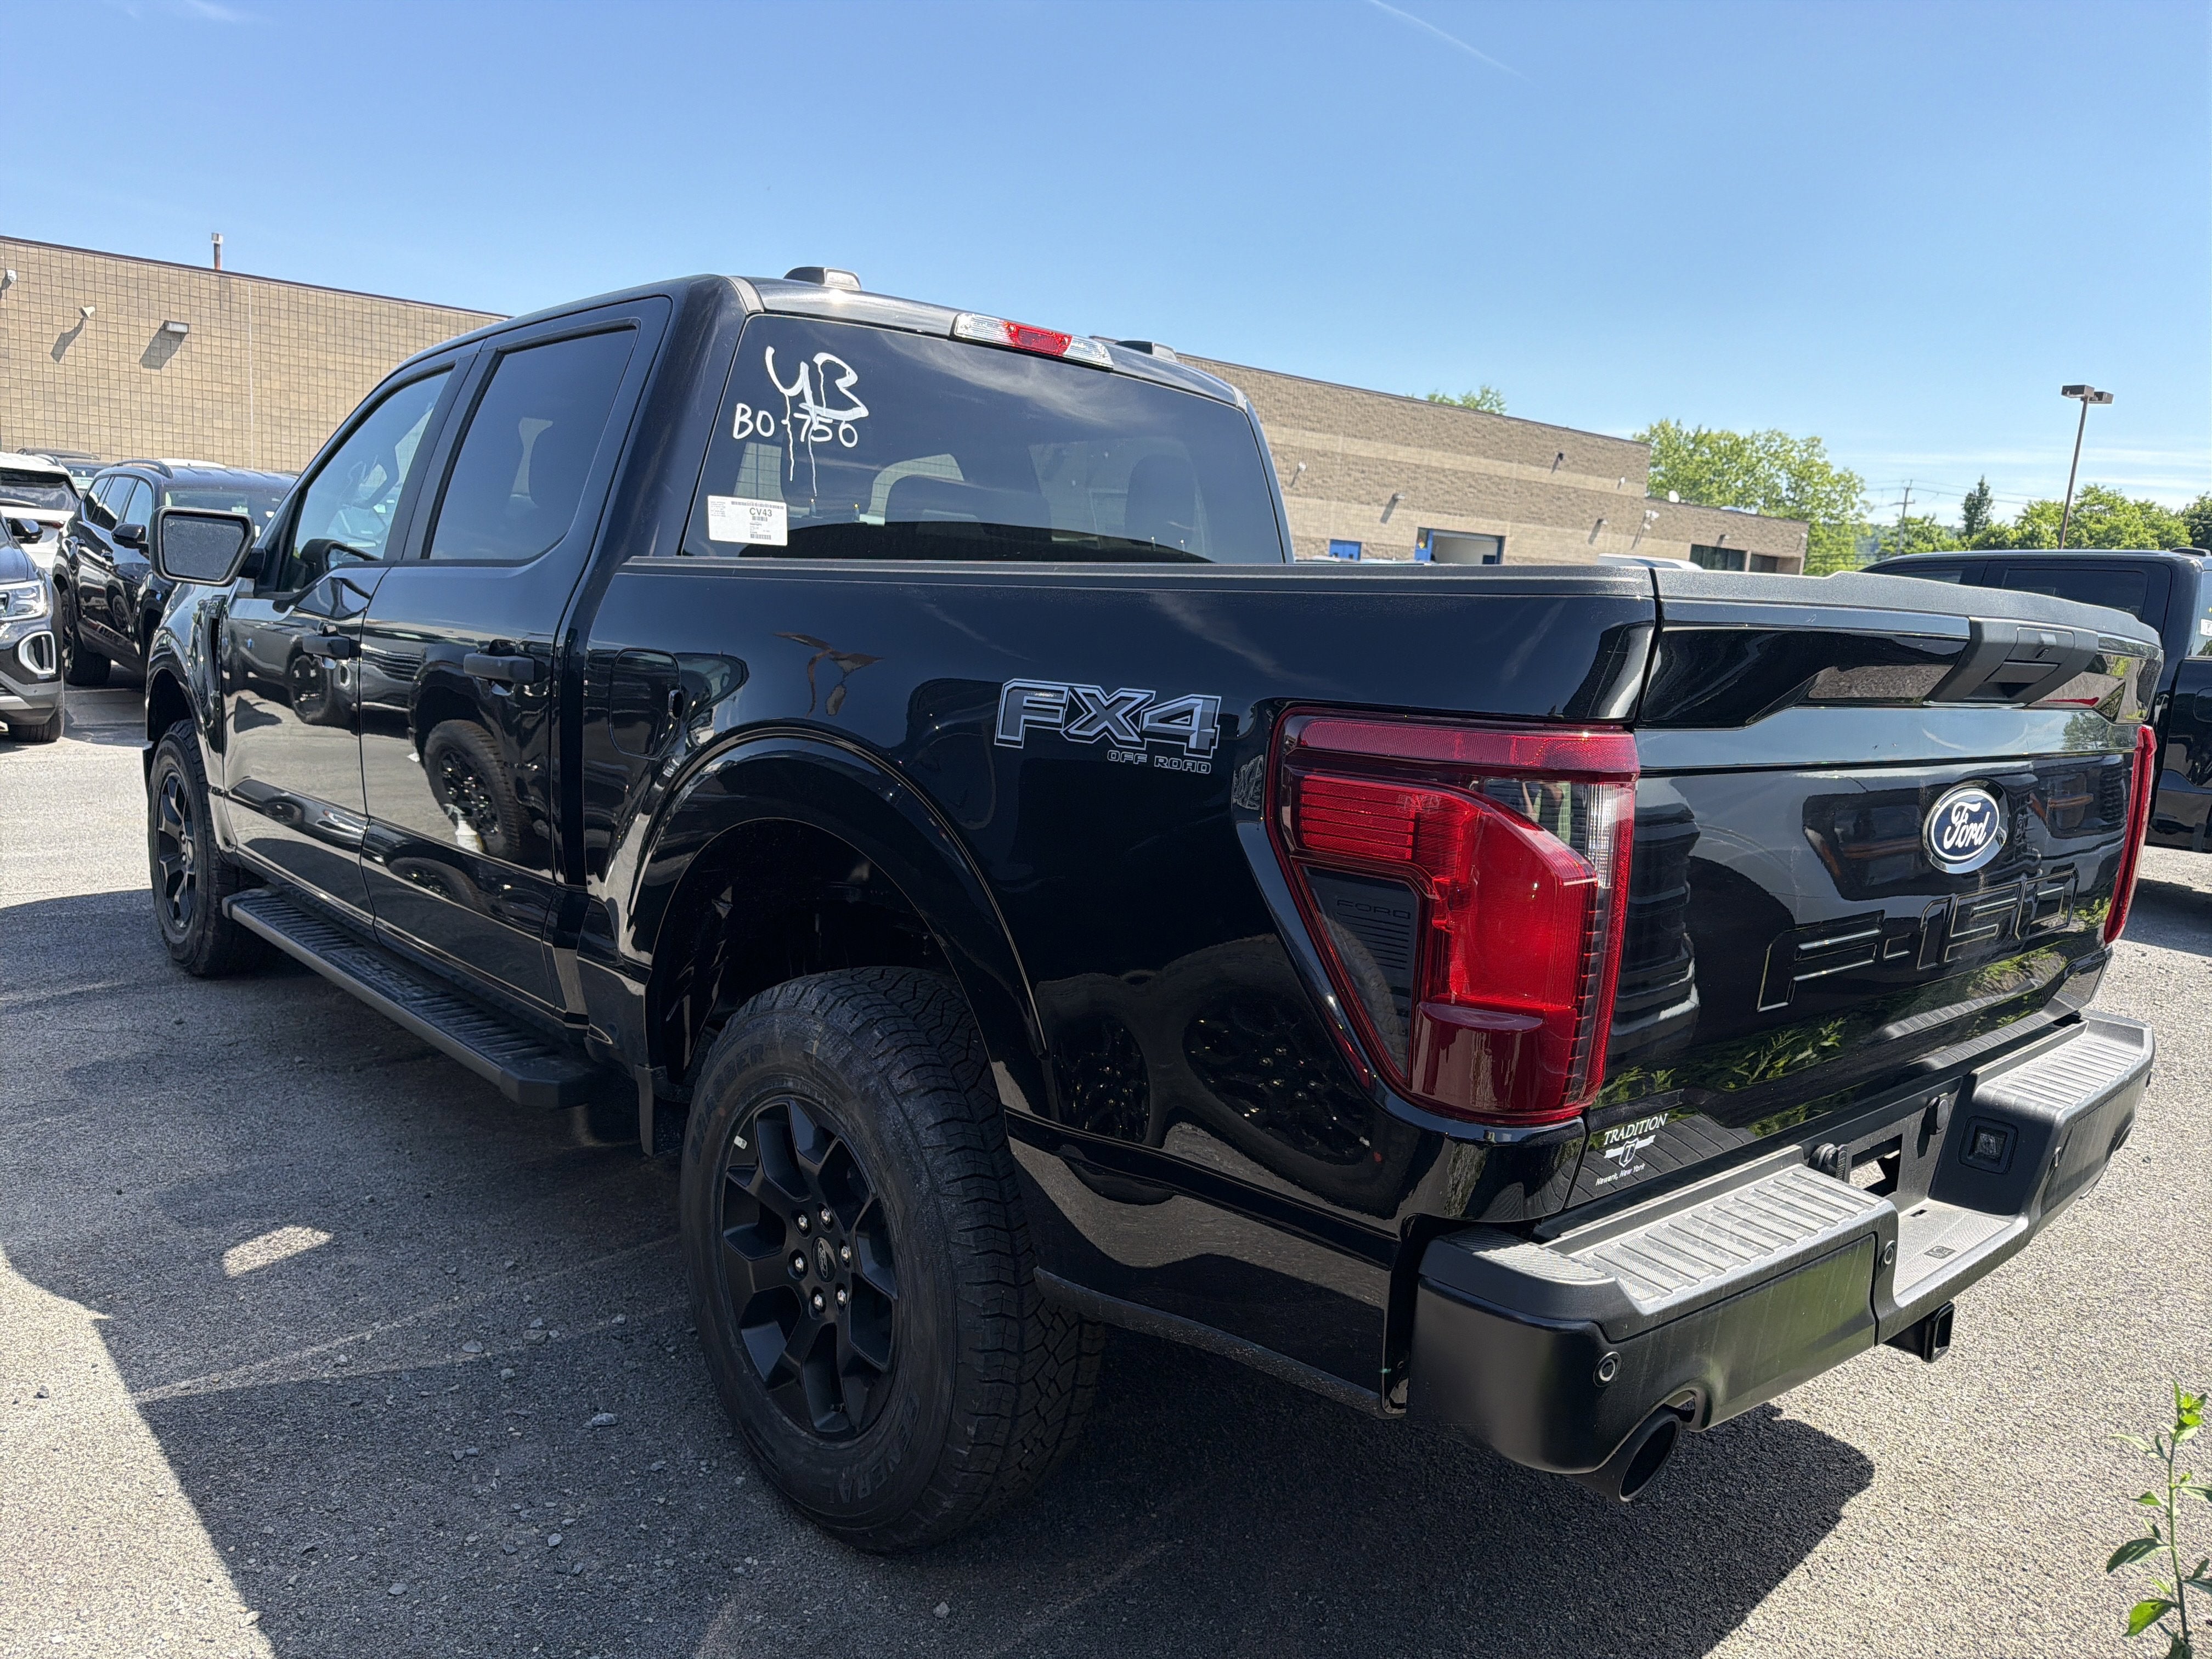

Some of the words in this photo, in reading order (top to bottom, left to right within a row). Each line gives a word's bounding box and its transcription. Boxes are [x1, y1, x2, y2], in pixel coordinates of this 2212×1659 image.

[749, 507, 772, 517] CV43
[994, 678, 1222, 759] FX4
[1107, 749, 1148, 765] OFF
[1154, 755, 1211, 775] ROAD
[1942, 800, 1991, 850] Ford
[1336, 899, 1411, 919] FORD
[1757, 866, 2080, 1013] F-150
[1603, 1113, 1669, 1146] TRADITION
[1619, 1168, 1633, 1178] New
[1633, 1162, 1646, 1173] York
